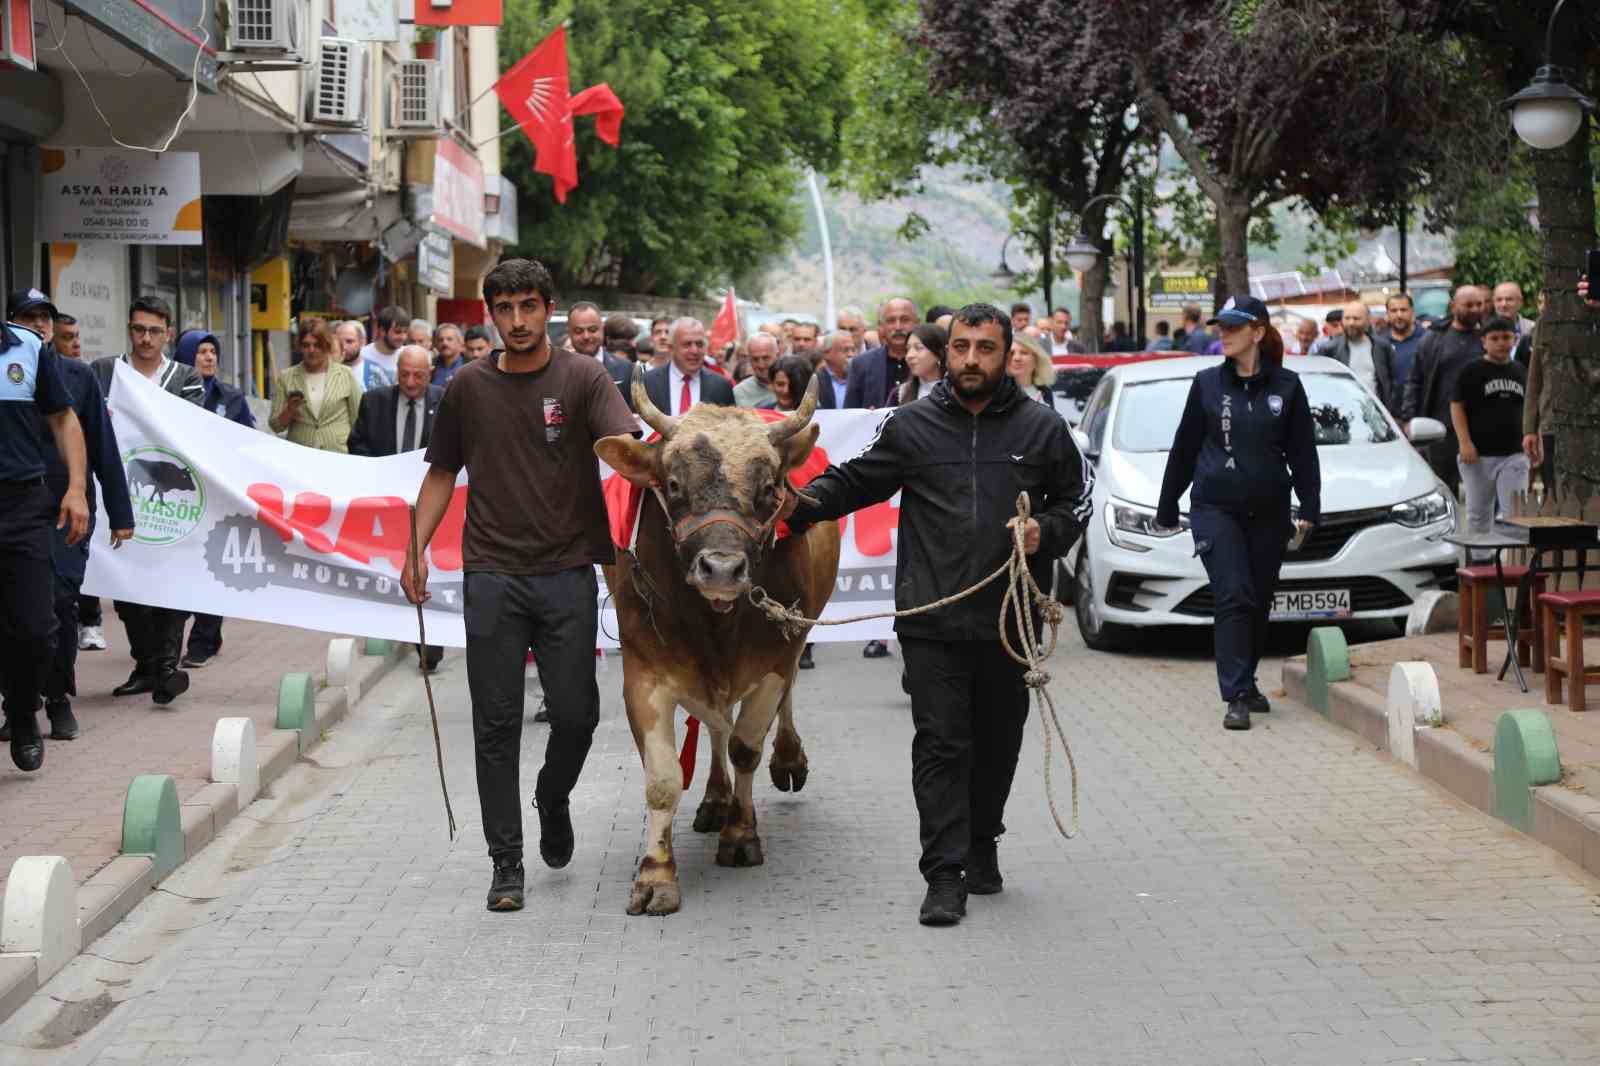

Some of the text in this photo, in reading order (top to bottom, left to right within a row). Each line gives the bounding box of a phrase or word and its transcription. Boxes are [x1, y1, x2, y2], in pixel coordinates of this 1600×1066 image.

[61, 184, 168, 196] ASYA HARİTA
[221, 526, 276, 574] 44.
[292, 562, 402, 595] KÜLTÜ
